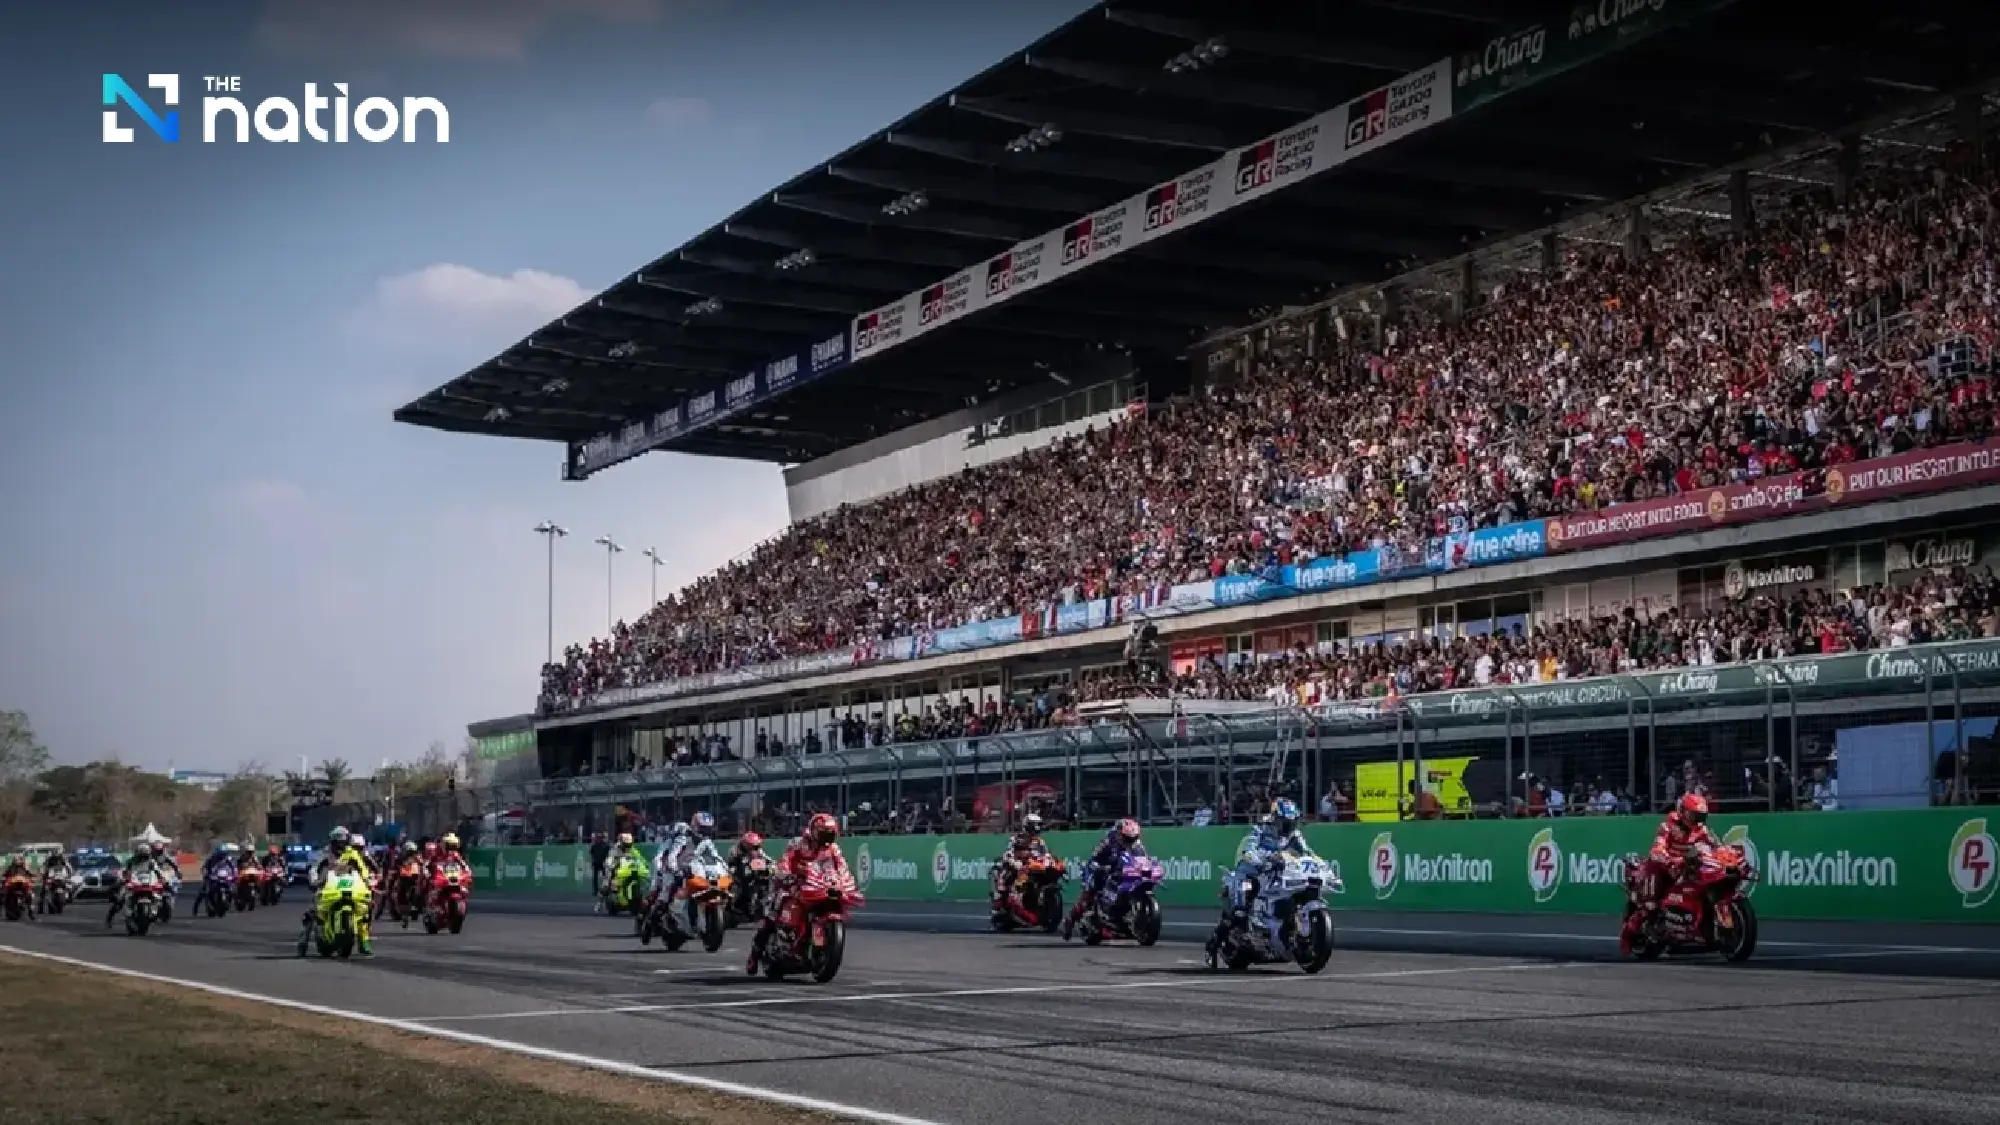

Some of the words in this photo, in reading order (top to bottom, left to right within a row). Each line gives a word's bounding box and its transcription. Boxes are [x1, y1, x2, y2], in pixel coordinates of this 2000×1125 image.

[1484, 25, 1547, 75] Chang
[1849, 470, 1875, 493] PUT
[1877, 465, 1903, 486] OUR
[1957, 449, 1989, 474] INTO
[1912, 539, 1975, 569] Chang
[1747, 565, 1815, 588] Maxnitron
[1404, 852, 1493, 883] Maxnitron
[1767, 850, 1898, 887] Maxnitron
